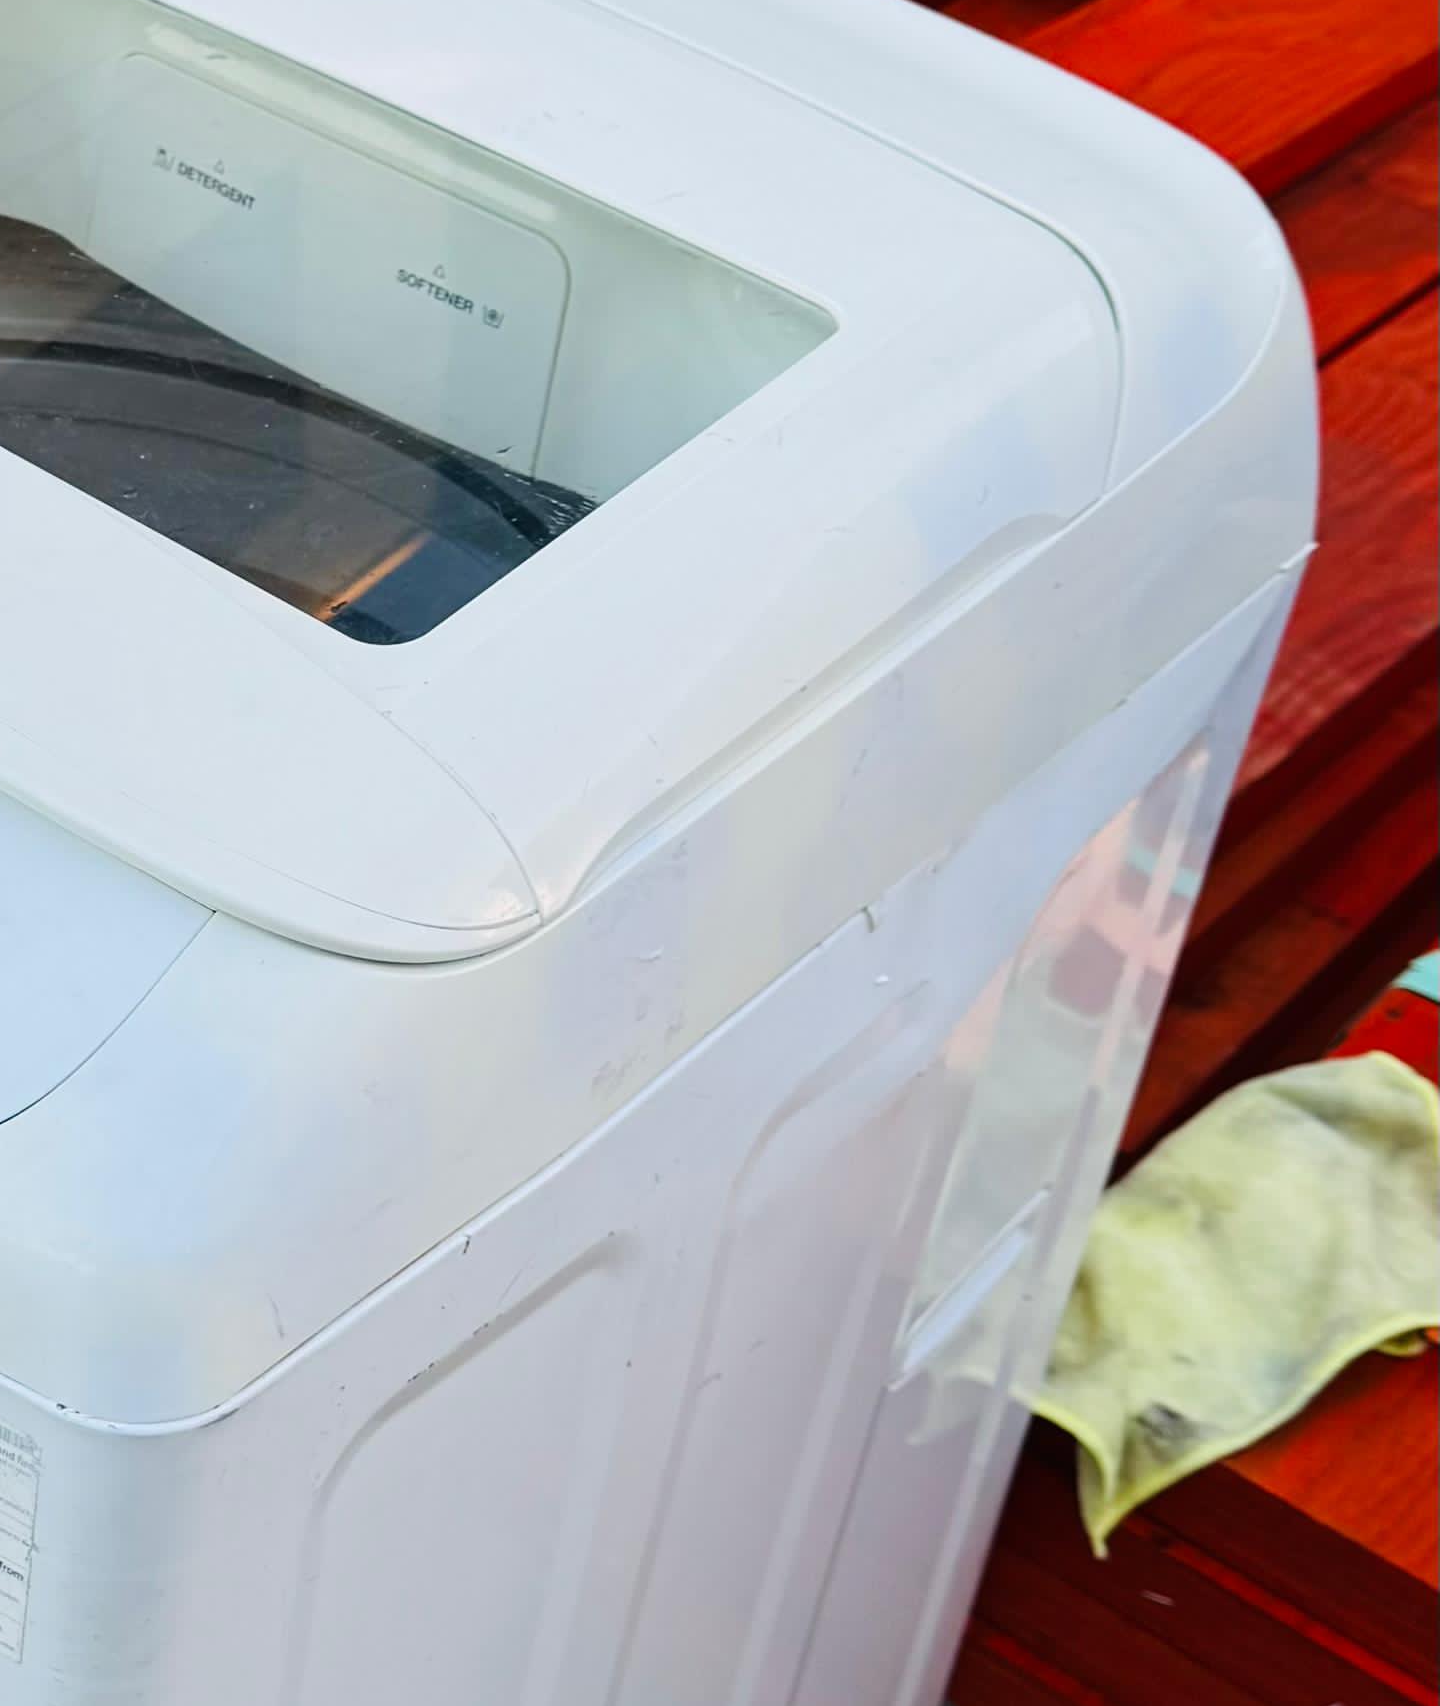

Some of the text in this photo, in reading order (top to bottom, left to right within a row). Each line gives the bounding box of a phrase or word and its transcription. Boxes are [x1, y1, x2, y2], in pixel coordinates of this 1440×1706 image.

[176, 161, 256, 210] DETERGENT
[396, 268, 475, 314] SOFTENER
[0, 1560, 24, 1581] from
